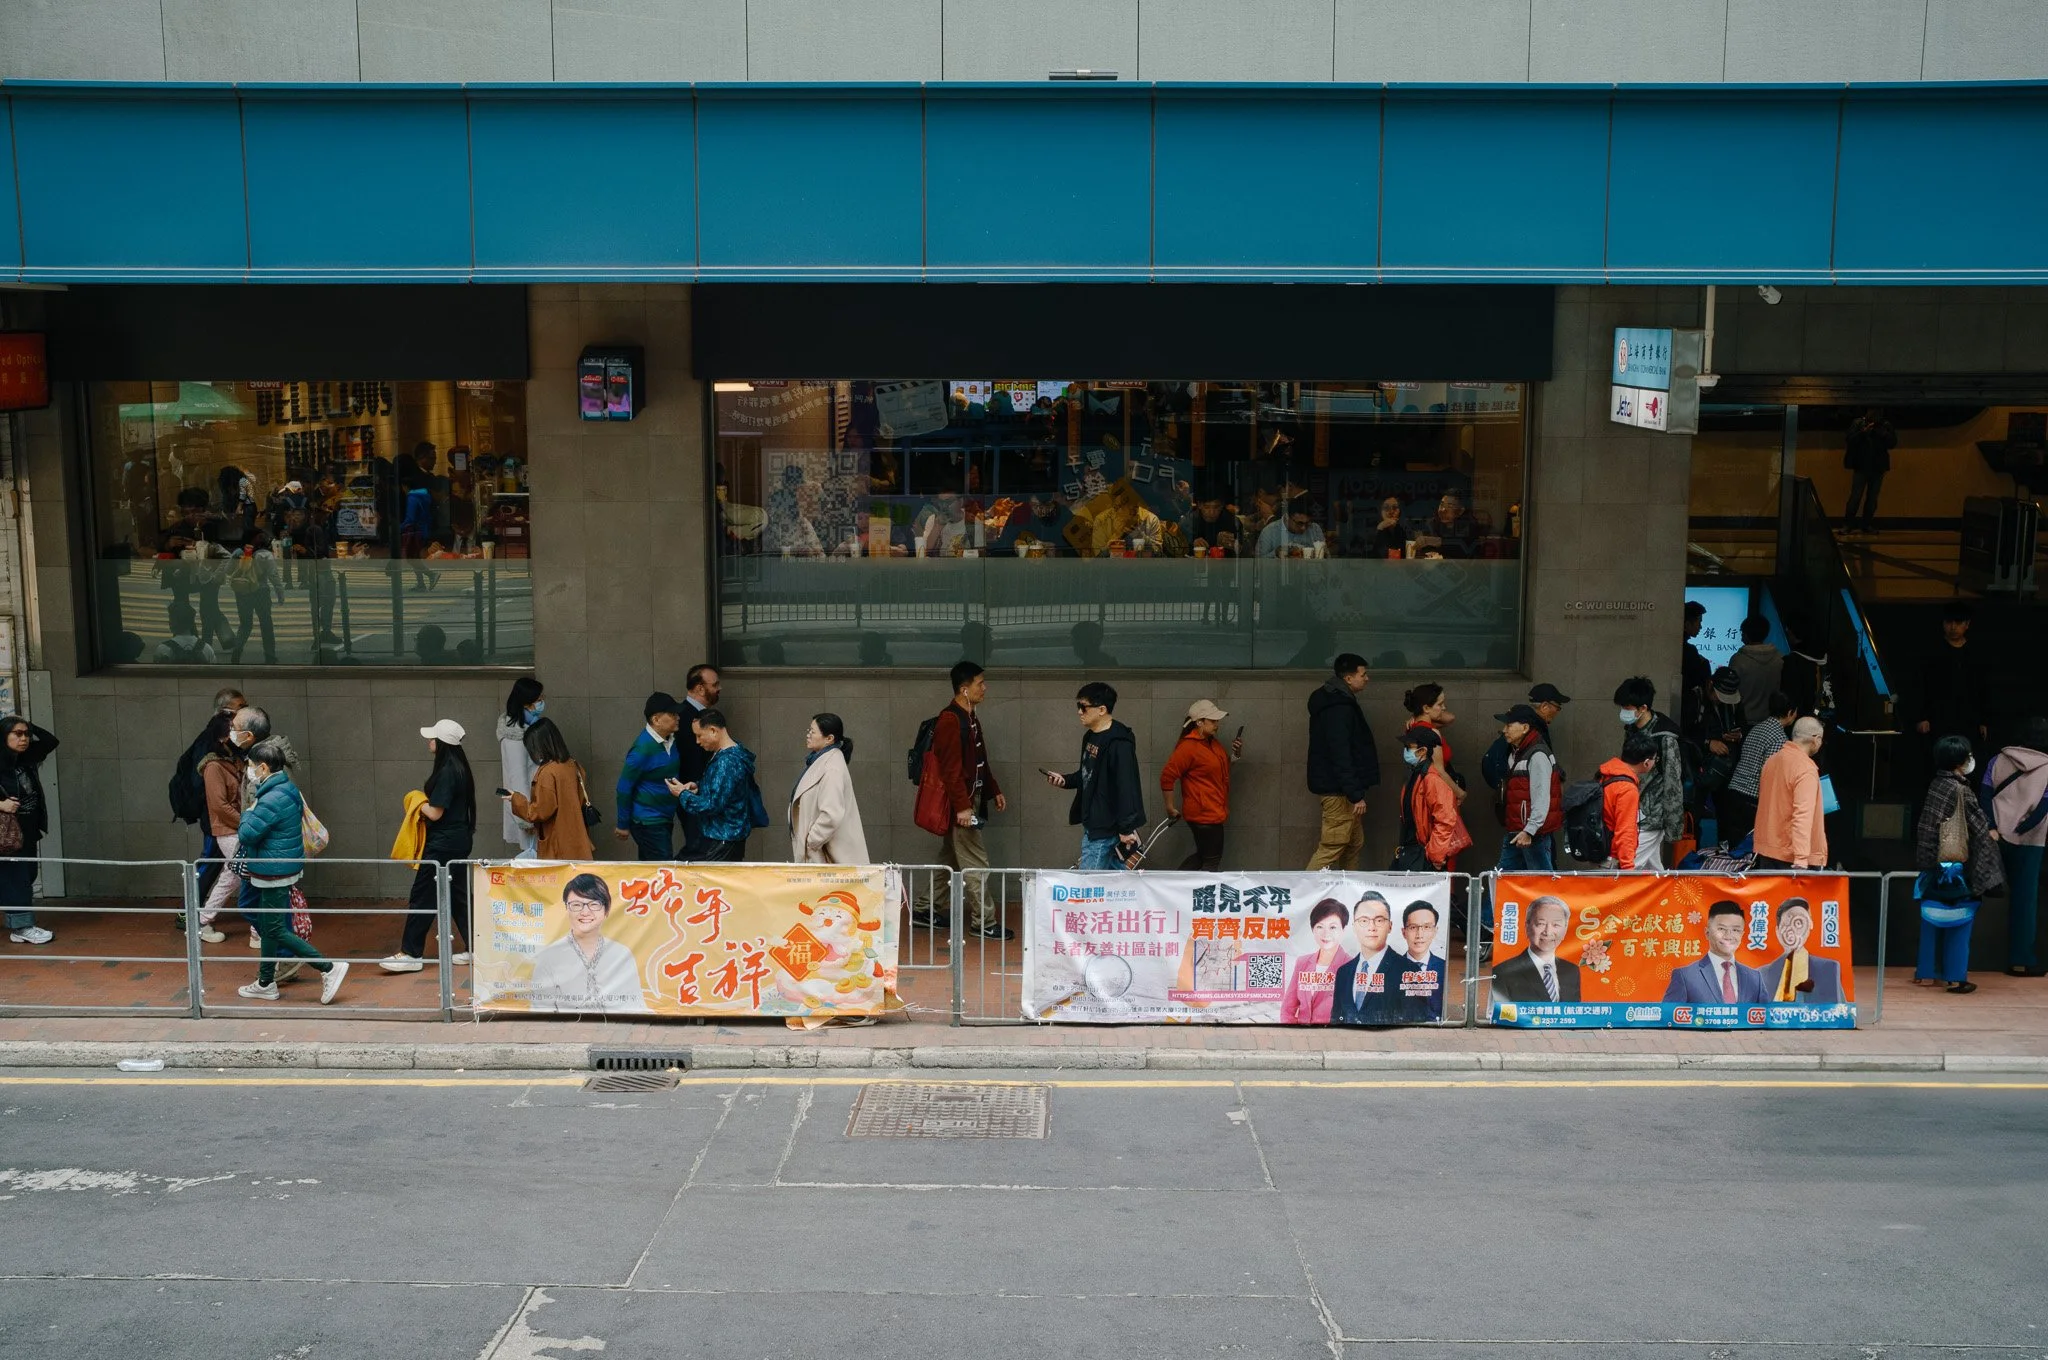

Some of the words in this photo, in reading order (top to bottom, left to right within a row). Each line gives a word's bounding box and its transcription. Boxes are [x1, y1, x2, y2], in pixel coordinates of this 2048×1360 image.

[1576, 602, 1584, 610] C
[1586, 602, 1603, 610] WU
[1605, 602, 1656, 610] BUILDING
[1717, 643, 1738, 651] BANK
[1070, 886, 1105, 898] 民建聯
[1192, 883, 1291, 913] 路見不平
[1052, 909, 1180, 934] 「齡活出行」
[1192, 917, 1291, 940] 齊齊反映
[1504, 904, 1517, 943] 易志明
[1602, 914, 1685, 933] 金蛇獻福
[1750, 903, 1767, 948] 林偉文
[786, 939, 813, 966] 福
[1052, 941, 1179, 956] 長者友善社區計劃
[1620, 938, 1702, 957] 百業興旺
[664, 937, 771, 1010] 吉祥
[1519, 1006, 1561, 1015] 立法會議員
